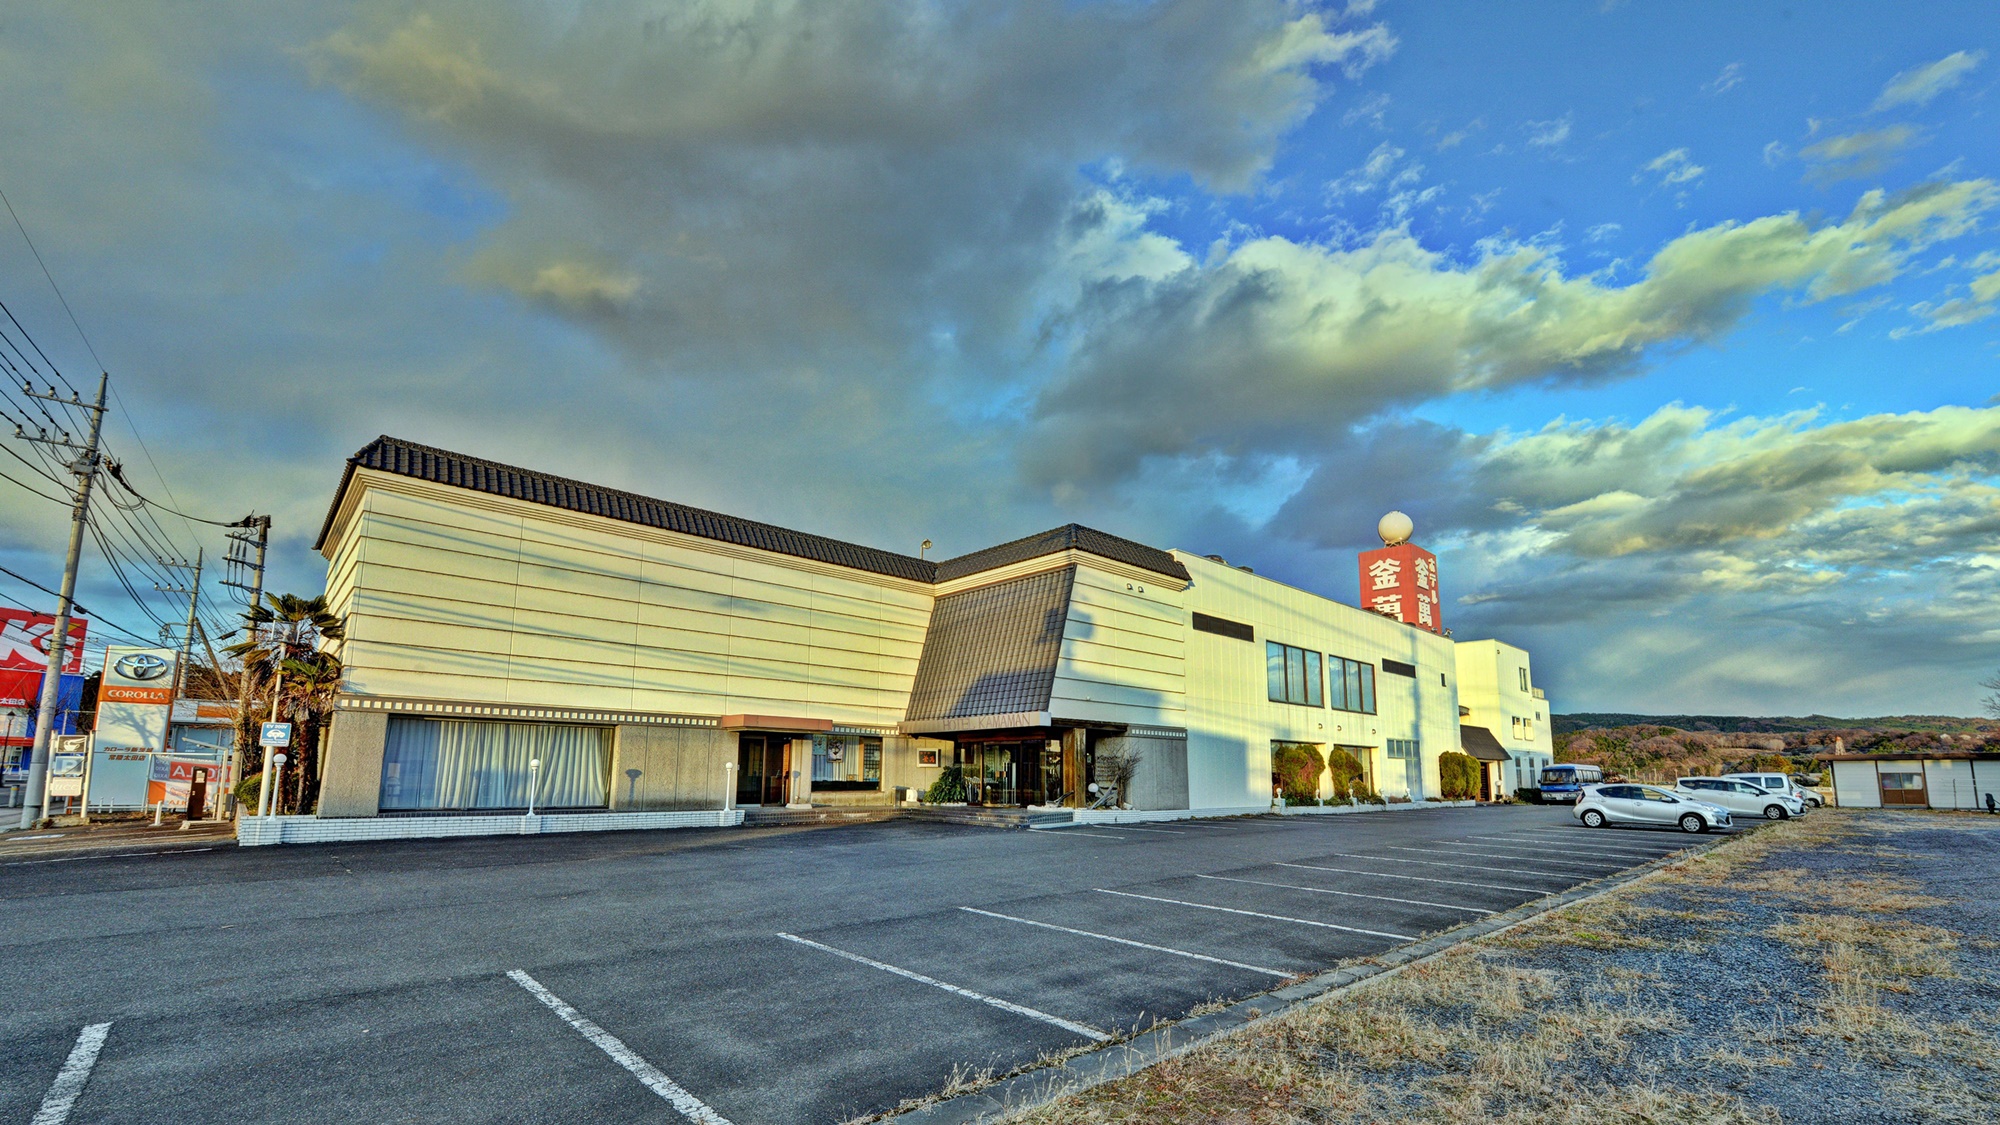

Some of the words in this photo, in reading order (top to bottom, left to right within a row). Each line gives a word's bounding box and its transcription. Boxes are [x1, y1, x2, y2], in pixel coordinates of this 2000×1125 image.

[1428, 558, 1438, 604] ホテル
[1415, 557, 1432, 626] 釜萬
[108, 689, 165, 700] COROLLA
[978, 714, 1031, 729] KAMAMAN
[61, 759, 78, 773] P
